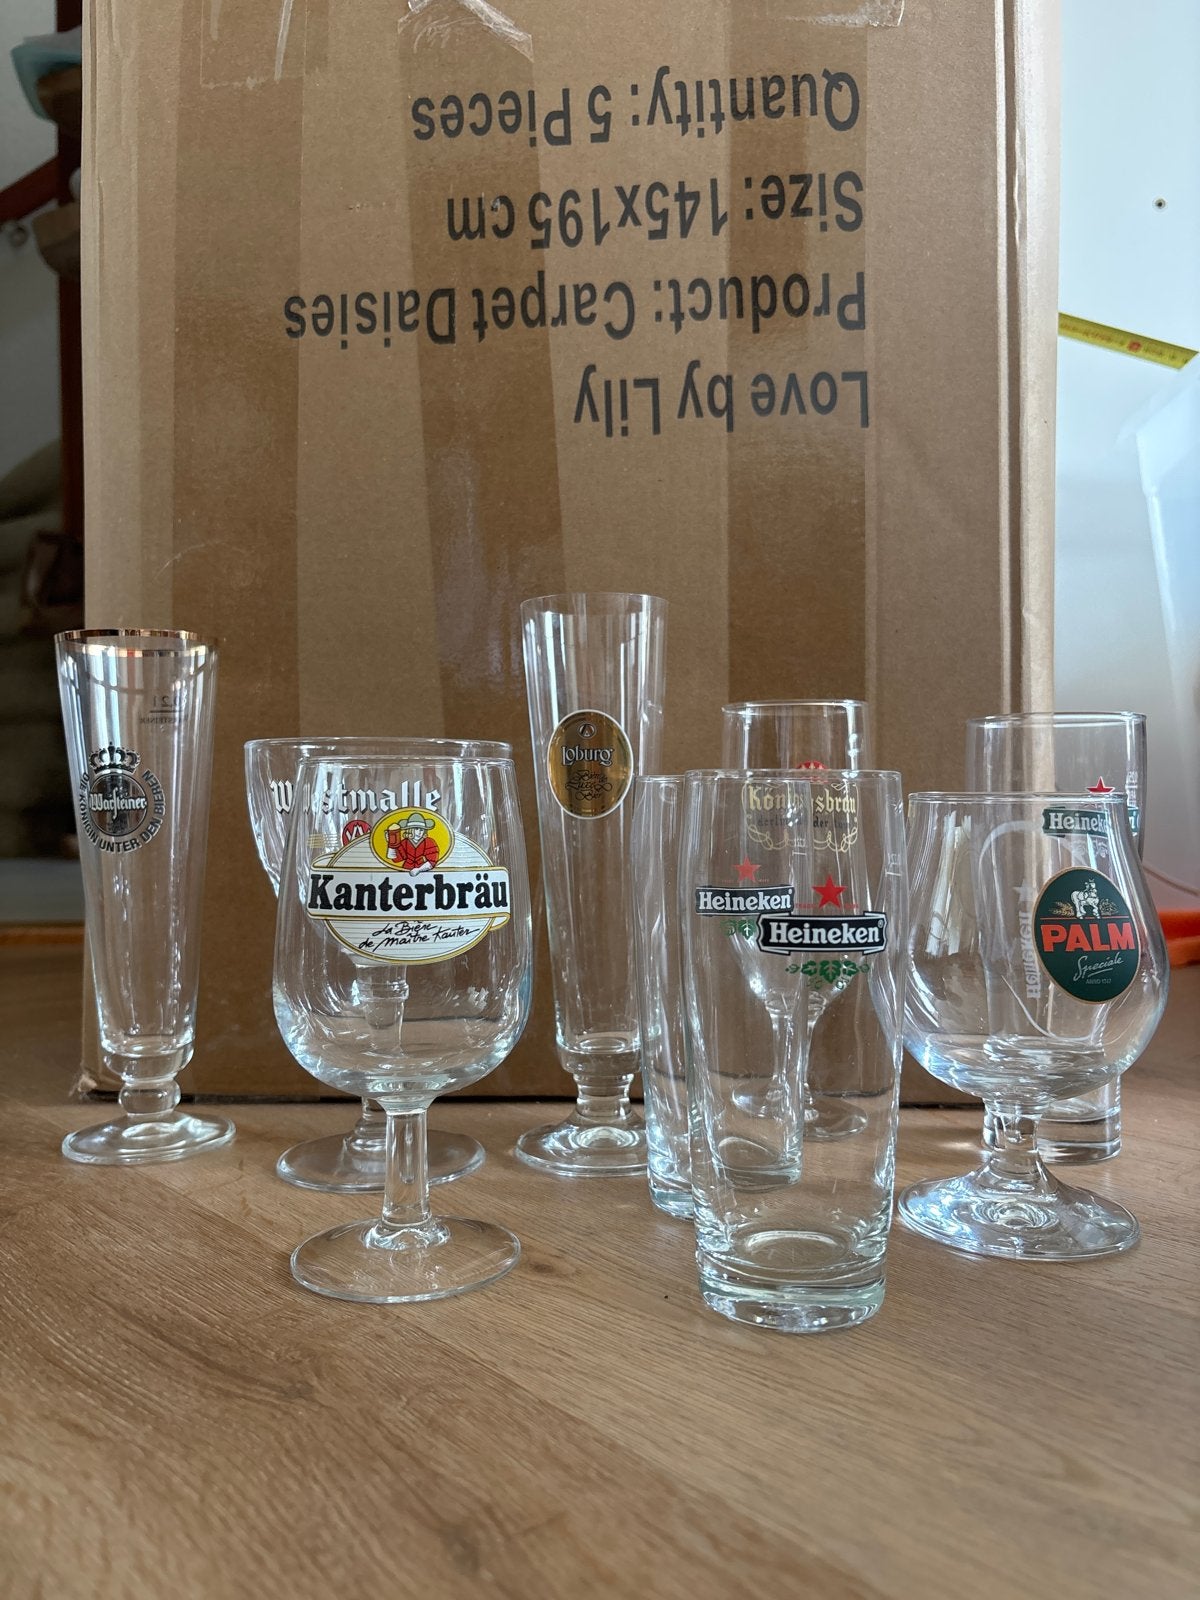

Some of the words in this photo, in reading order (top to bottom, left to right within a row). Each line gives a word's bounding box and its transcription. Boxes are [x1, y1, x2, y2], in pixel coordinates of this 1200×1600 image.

[411, 90, 572, 147] Pieces
[588, 85, 612, 144] 5
[632, 66, 860, 140] Quantity:
[446, 193, 515, 243] cm
[527, 178, 729, 250] 145x195
[745, 171, 864, 233] Size:
[283, 287, 456, 350] Daisies
[471, 271, 636, 343] Carpet
[653, 271, 866, 334] Product:
[573, 364, 661, 438] Lily
[677, 360, 733, 433] by
[750, 371, 870, 429] Love
[561, 745, 614, 767] Loburg
[142, 768, 166, 816] BIEREN
[99, 838, 142, 853] UNTER
[140, 816, 163, 843] DEN
[308, 873, 508, 912] Kanterbräu
[698, 891, 792, 911] Heineken
[358, 938, 374, 949] de
[372, 923, 393, 936] La
[768, 921, 881, 945] Heineken
[1039, 922, 1136, 952] PALM
[1073, 951, 1125, 982] Speciale
